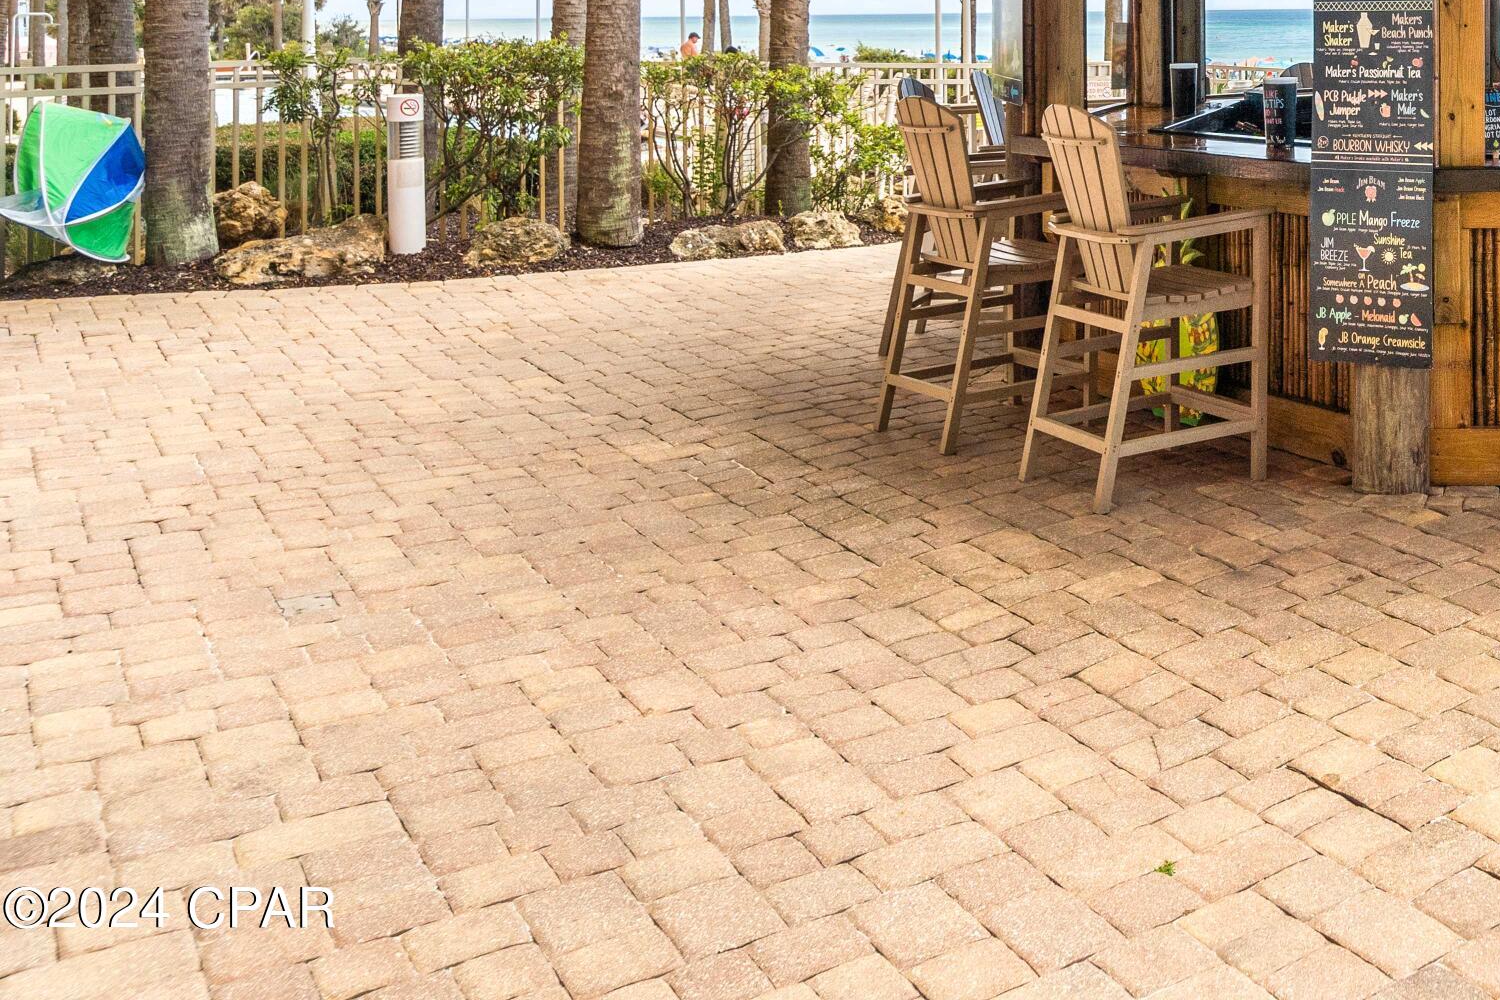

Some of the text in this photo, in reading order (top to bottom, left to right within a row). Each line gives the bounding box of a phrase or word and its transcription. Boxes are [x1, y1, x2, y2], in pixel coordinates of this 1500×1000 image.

[1323, 22, 1354, 33] Maker's
[1382, 27, 1432, 38] Beach Punch
[1324, 36, 1352, 47] Shaker
[1325, 65, 1421, 79] Maker's Passionfruit Tea
[1324, 90, 1338, 102] PCB
[1391, 89, 1423, 102] Maker's
[1330, 103, 1360, 119] Jumper
[1397, 102, 1417, 115] Mule
[1333, 139, 1410, 153] BOURBON WHISKY
[1359, 210, 1387, 231] Mango
[1391, 212, 1420, 229] Freeze
[1321, 237, 1334, 248] JIM
[1374, 233, 1406, 246] Sunshine
[1321, 249, 1349, 261] BREEZE
[1400, 247, 1412, 259] Tea
[1323, 274, 1397, 291] Somewhere A Peach
[1316, 307, 1395, 324] JB Apple Melonaid
[1338, 332, 1426, 350] JB Orange Creamsicle
